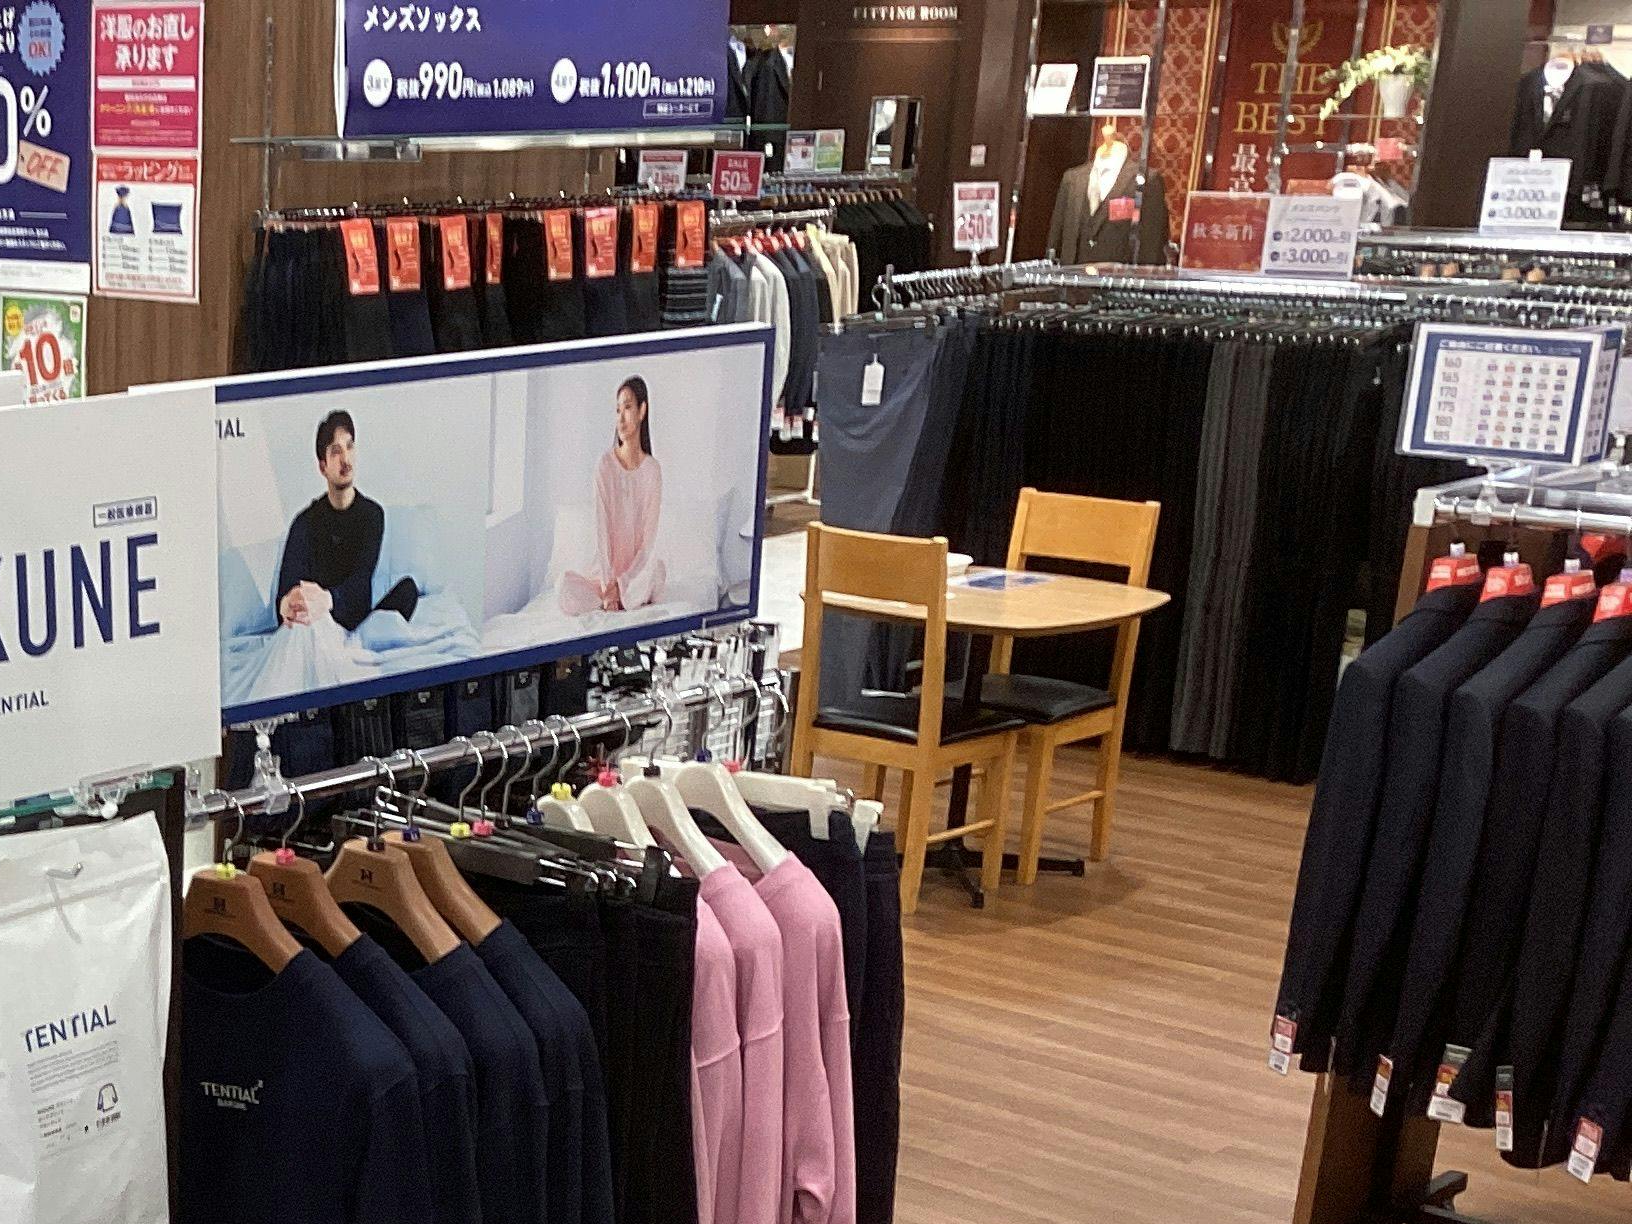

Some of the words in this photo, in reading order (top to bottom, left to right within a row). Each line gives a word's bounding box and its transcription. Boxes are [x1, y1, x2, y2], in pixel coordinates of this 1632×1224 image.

[99, 12, 196, 42] 洋服のお直し
[363, 4, 482, 33] メンズソックス
[853, 6, 916, 21] FITTING
[920, 6, 958, 21] ROOM
[115, 43, 179, 73] 承ります
[1249, 62, 1334, 95] THE
[1232, 102, 1328, 136] BEST
[26, 151, 65, 182] OFF
[1192, 222, 1254, 242] 秋冬新作
[20, 1004, 118, 1054] TENTIAL
